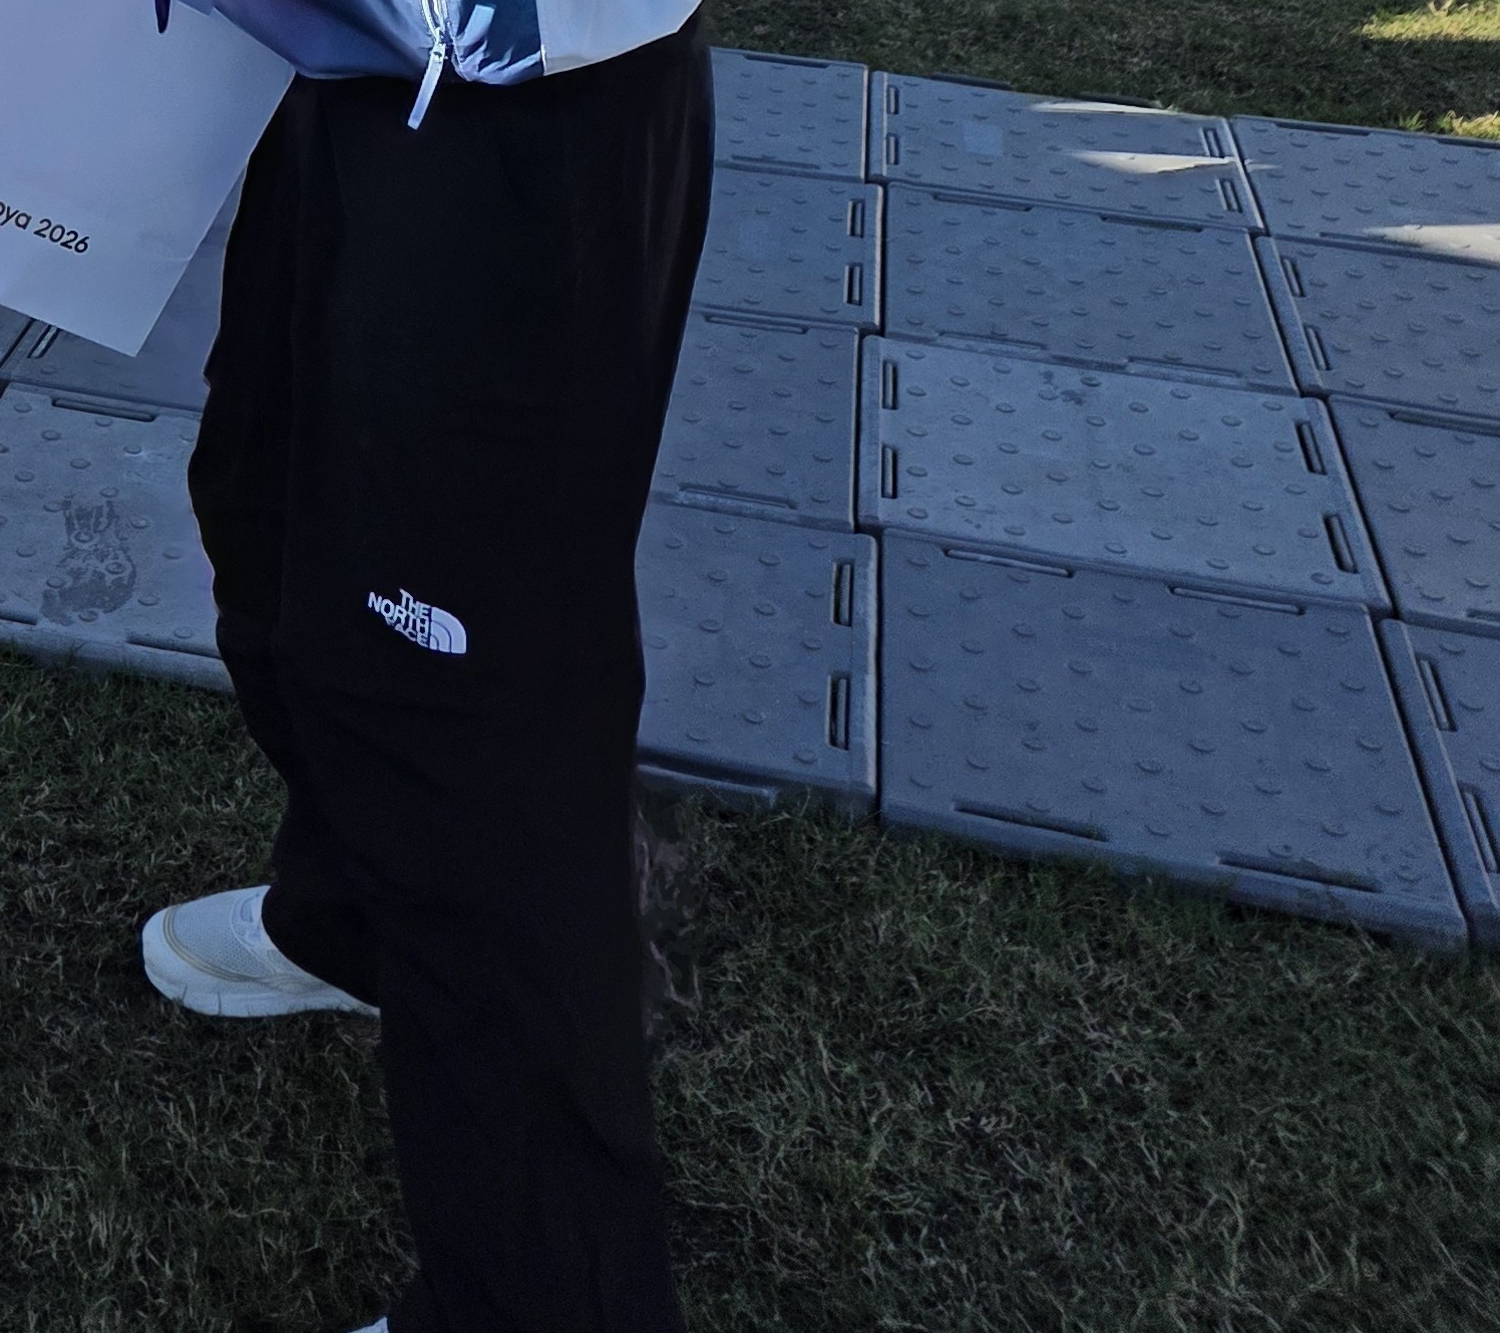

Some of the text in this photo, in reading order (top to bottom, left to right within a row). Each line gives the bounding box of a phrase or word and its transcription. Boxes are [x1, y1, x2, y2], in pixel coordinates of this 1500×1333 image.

[33, 218, 90, 254] 2026
[367, 591, 430, 635] NORTH
[399, 588, 431, 617] THE
